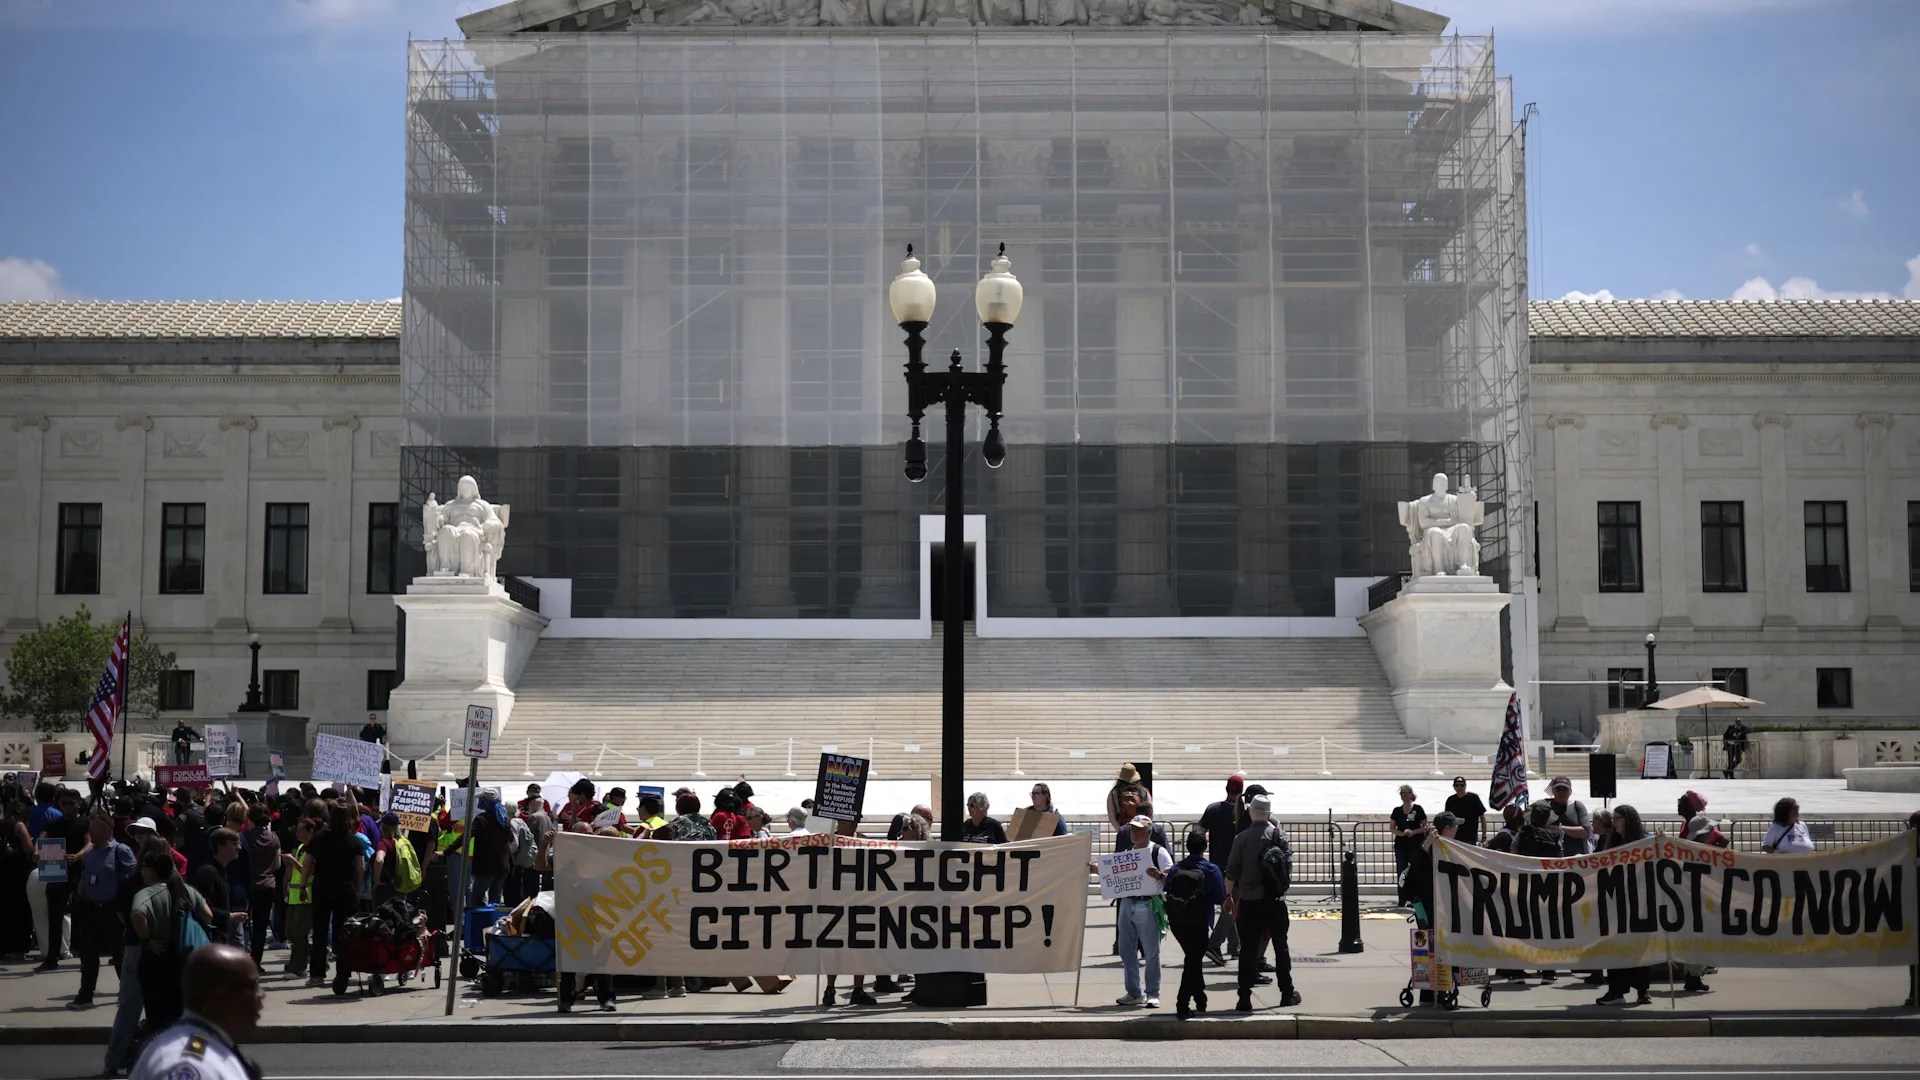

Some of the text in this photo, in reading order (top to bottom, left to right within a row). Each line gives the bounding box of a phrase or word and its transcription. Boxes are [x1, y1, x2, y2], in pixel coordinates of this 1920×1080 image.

[475, 709, 484, 719] NO
[468, 719, 489, 730] PARKING
[319, 736, 380, 757] IMMIGRANTS
[471, 739, 483, 747] TIME
[315, 748, 380, 768] MADE AMERICA
[313, 757, 380, 777] GREAT! UPHOLD
[825, 755, 863, 785] NO!
[397, 789, 430, 800] Trump
[831, 789, 856, 798] Humanity
[833, 795, 856, 804] REFUSE
[393, 796, 431, 807] Fascist
[830, 801, 849, 809] Accept
[391, 803, 430, 814] Regime
[817, 804, 858, 816] Fascist America
[400, 820, 425, 829] OW!!!
[1113, 852, 1142, 864] PEOPLE
[691, 847, 1041, 893] BIRTHRIGHT
[1111, 862, 1138, 875] BLEED
[1106, 874, 1144, 888] Billionaire
[1114, 881, 1142, 894] GREED
[556, 844, 672, 960] HANDS
[1437, 859, 1904, 940] TRUMP MUST GO NOW
[690, 904, 1055, 950] CITIZENSHIP!
